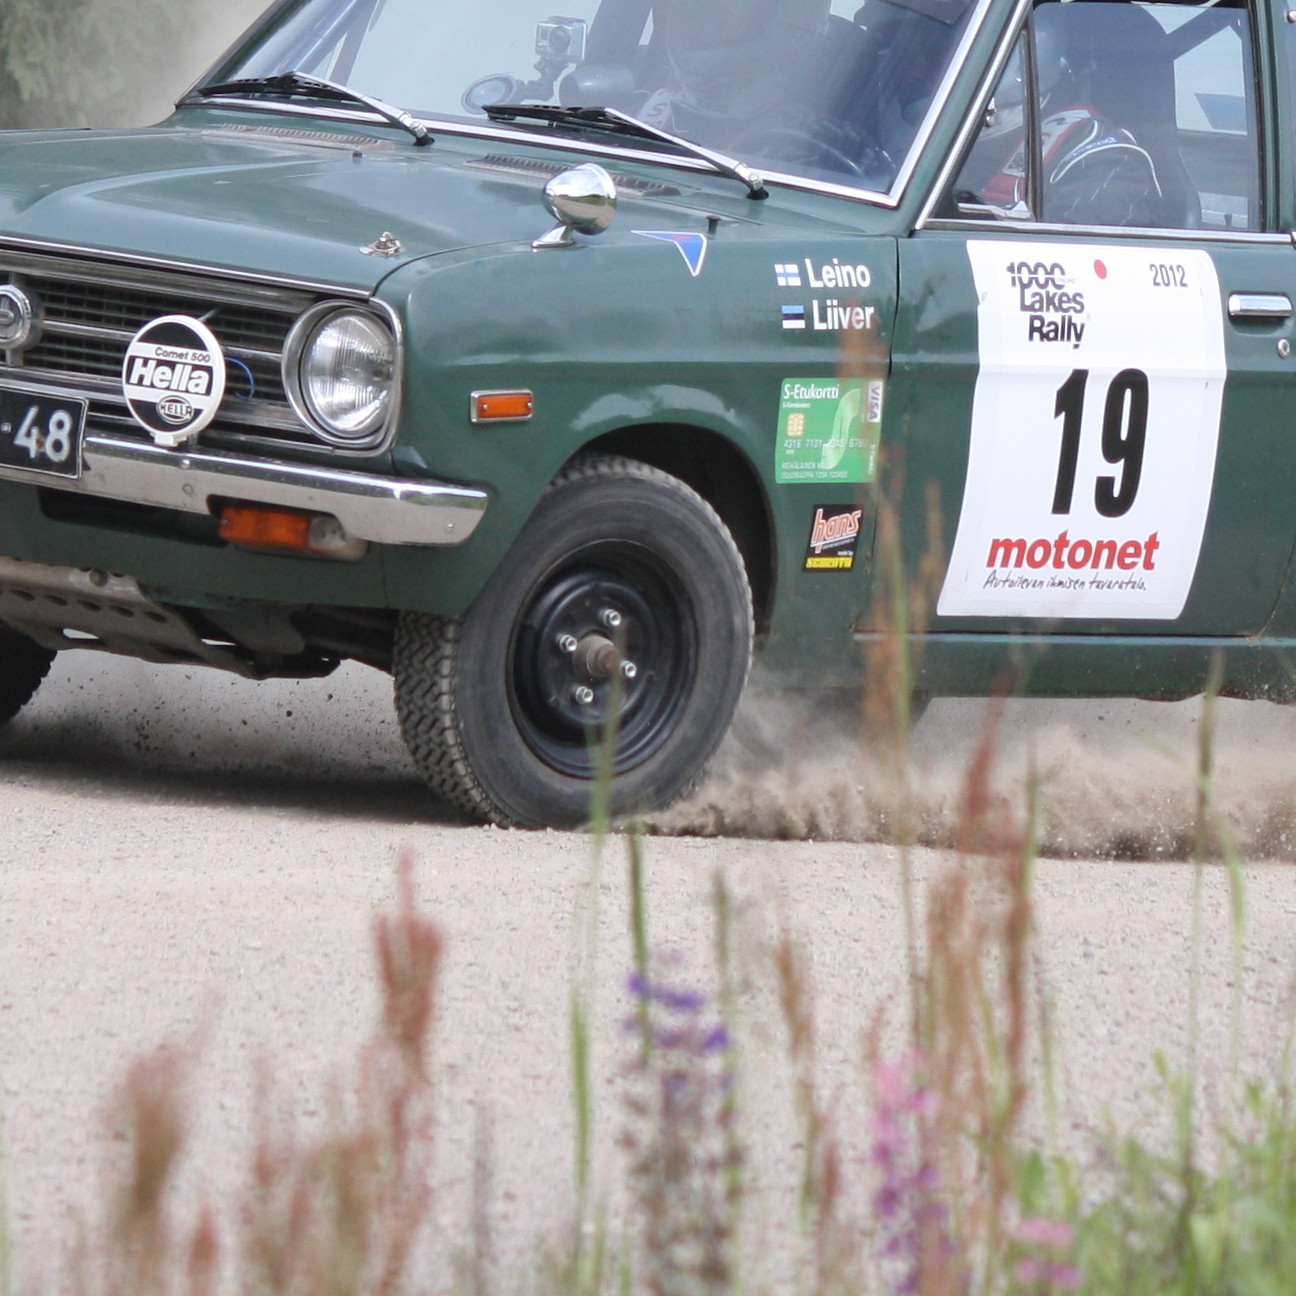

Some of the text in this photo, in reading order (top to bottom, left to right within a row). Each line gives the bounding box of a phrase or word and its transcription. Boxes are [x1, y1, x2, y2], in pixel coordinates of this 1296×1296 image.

[804, 258, 871, 288] Leino
[1006, 261, 1066, 290] 1000
[1149, 263, 1188, 288] 2012
[812, 299, 874, 330] Liiver
[1020, 286, 1085, 314] Lakes
[1028, 314, 1085, 349] Rally
[155, 346, 210, 363] Comet 500
[129, 358, 209, 394] Hella
[783, 384, 840, 400] S-Etukortti
[869, 386, 881, 420] VISA
[1050, 368, 1150, 518] 19
[811, 508, 862, 554] hans
[986, 529, 1160, 570] motonet
